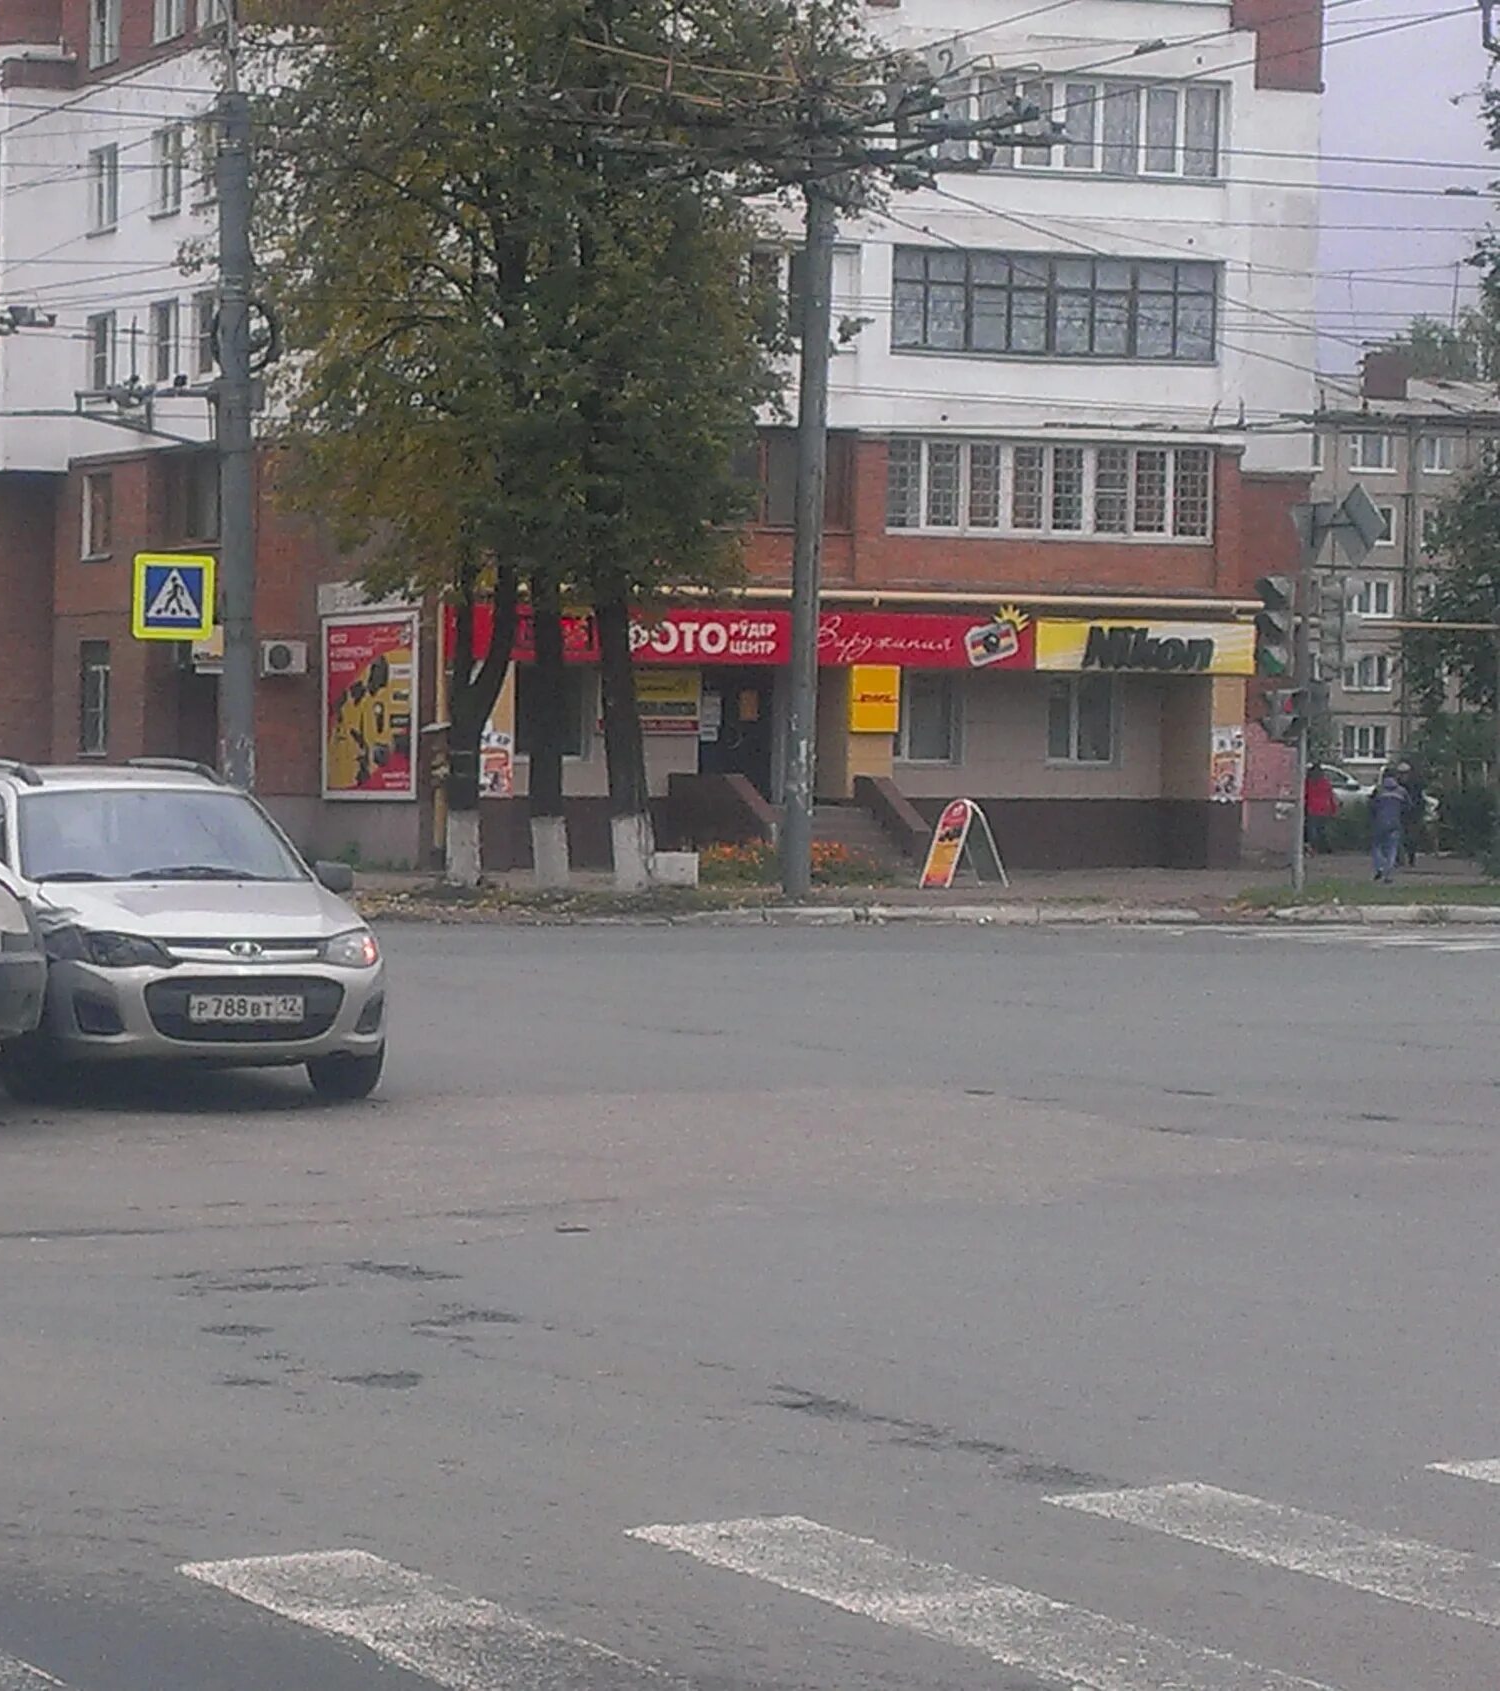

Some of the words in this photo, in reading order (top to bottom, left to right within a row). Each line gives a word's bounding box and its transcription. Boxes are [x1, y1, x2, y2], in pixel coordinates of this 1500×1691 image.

[729, 640, 776, 656] ЦЕНТР
[1082, 626, 1214, 669] Nikon
[281, 997, 297, 1011] 12
